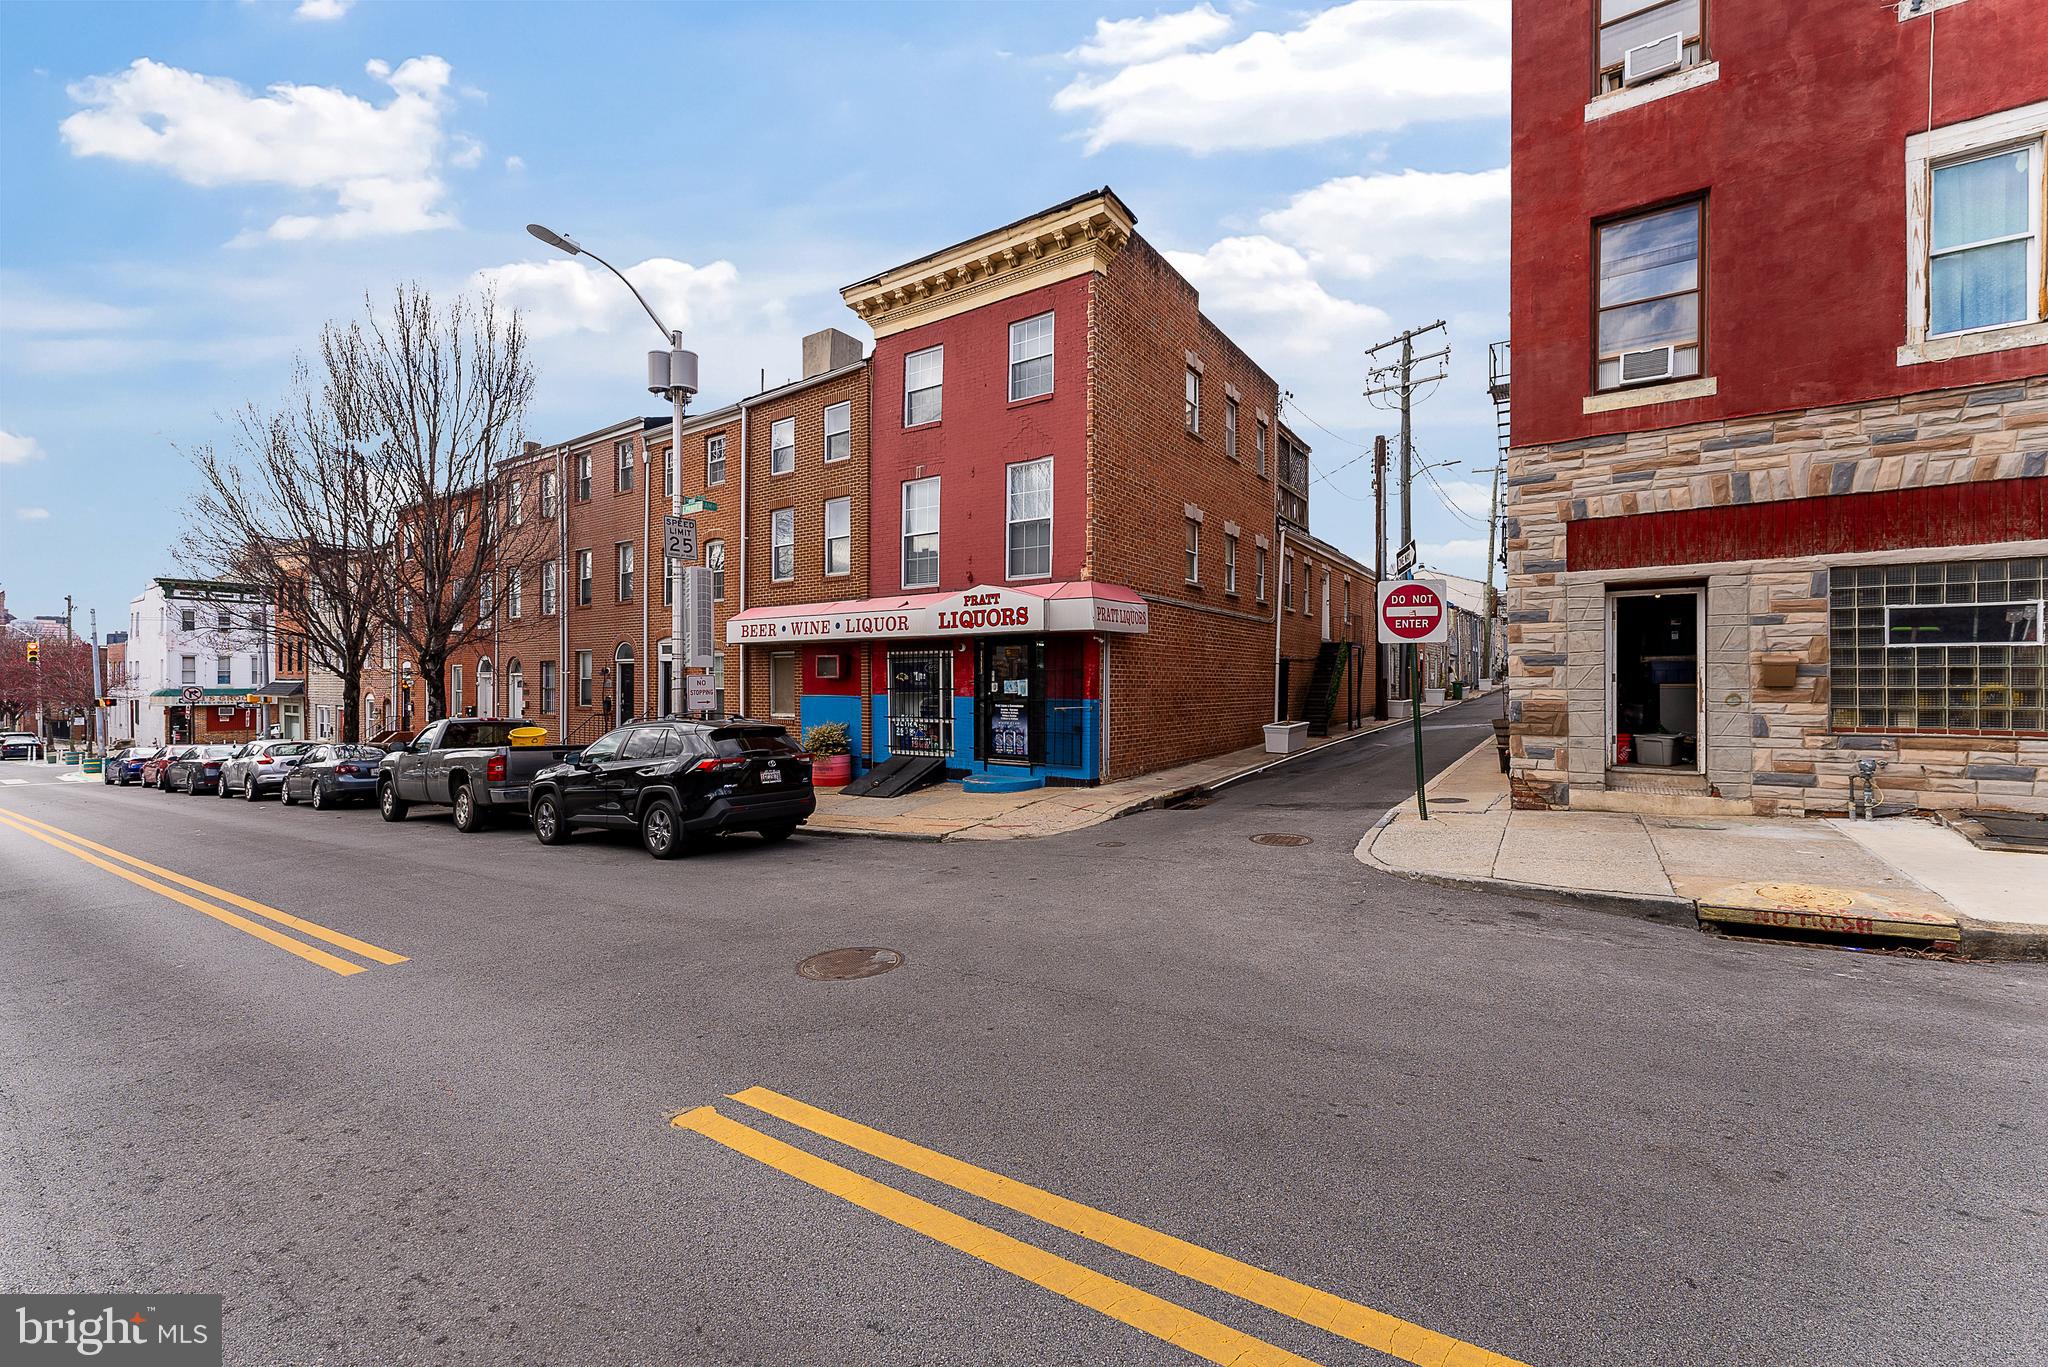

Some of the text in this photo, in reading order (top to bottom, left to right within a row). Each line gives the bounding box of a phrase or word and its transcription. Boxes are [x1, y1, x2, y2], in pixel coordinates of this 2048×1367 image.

[666, 518, 694, 529] SPEED
[669, 527, 692, 536] LIMIT
[669, 536, 693, 553] 25
[963, 593, 1001, 607] PRATT
[1391, 594, 1433, 604] DO NOT
[938, 607, 1029, 629] LIQUORS
[1096, 606, 1148, 626] PRATT LIQUORS
[739, 615, 910, 639] BEER WINE LIQUOR
[1395, 619, 1429, 628] ENTER
[696, 679, 707, 687] NO
[1754, 910, 1791, 928] NO
